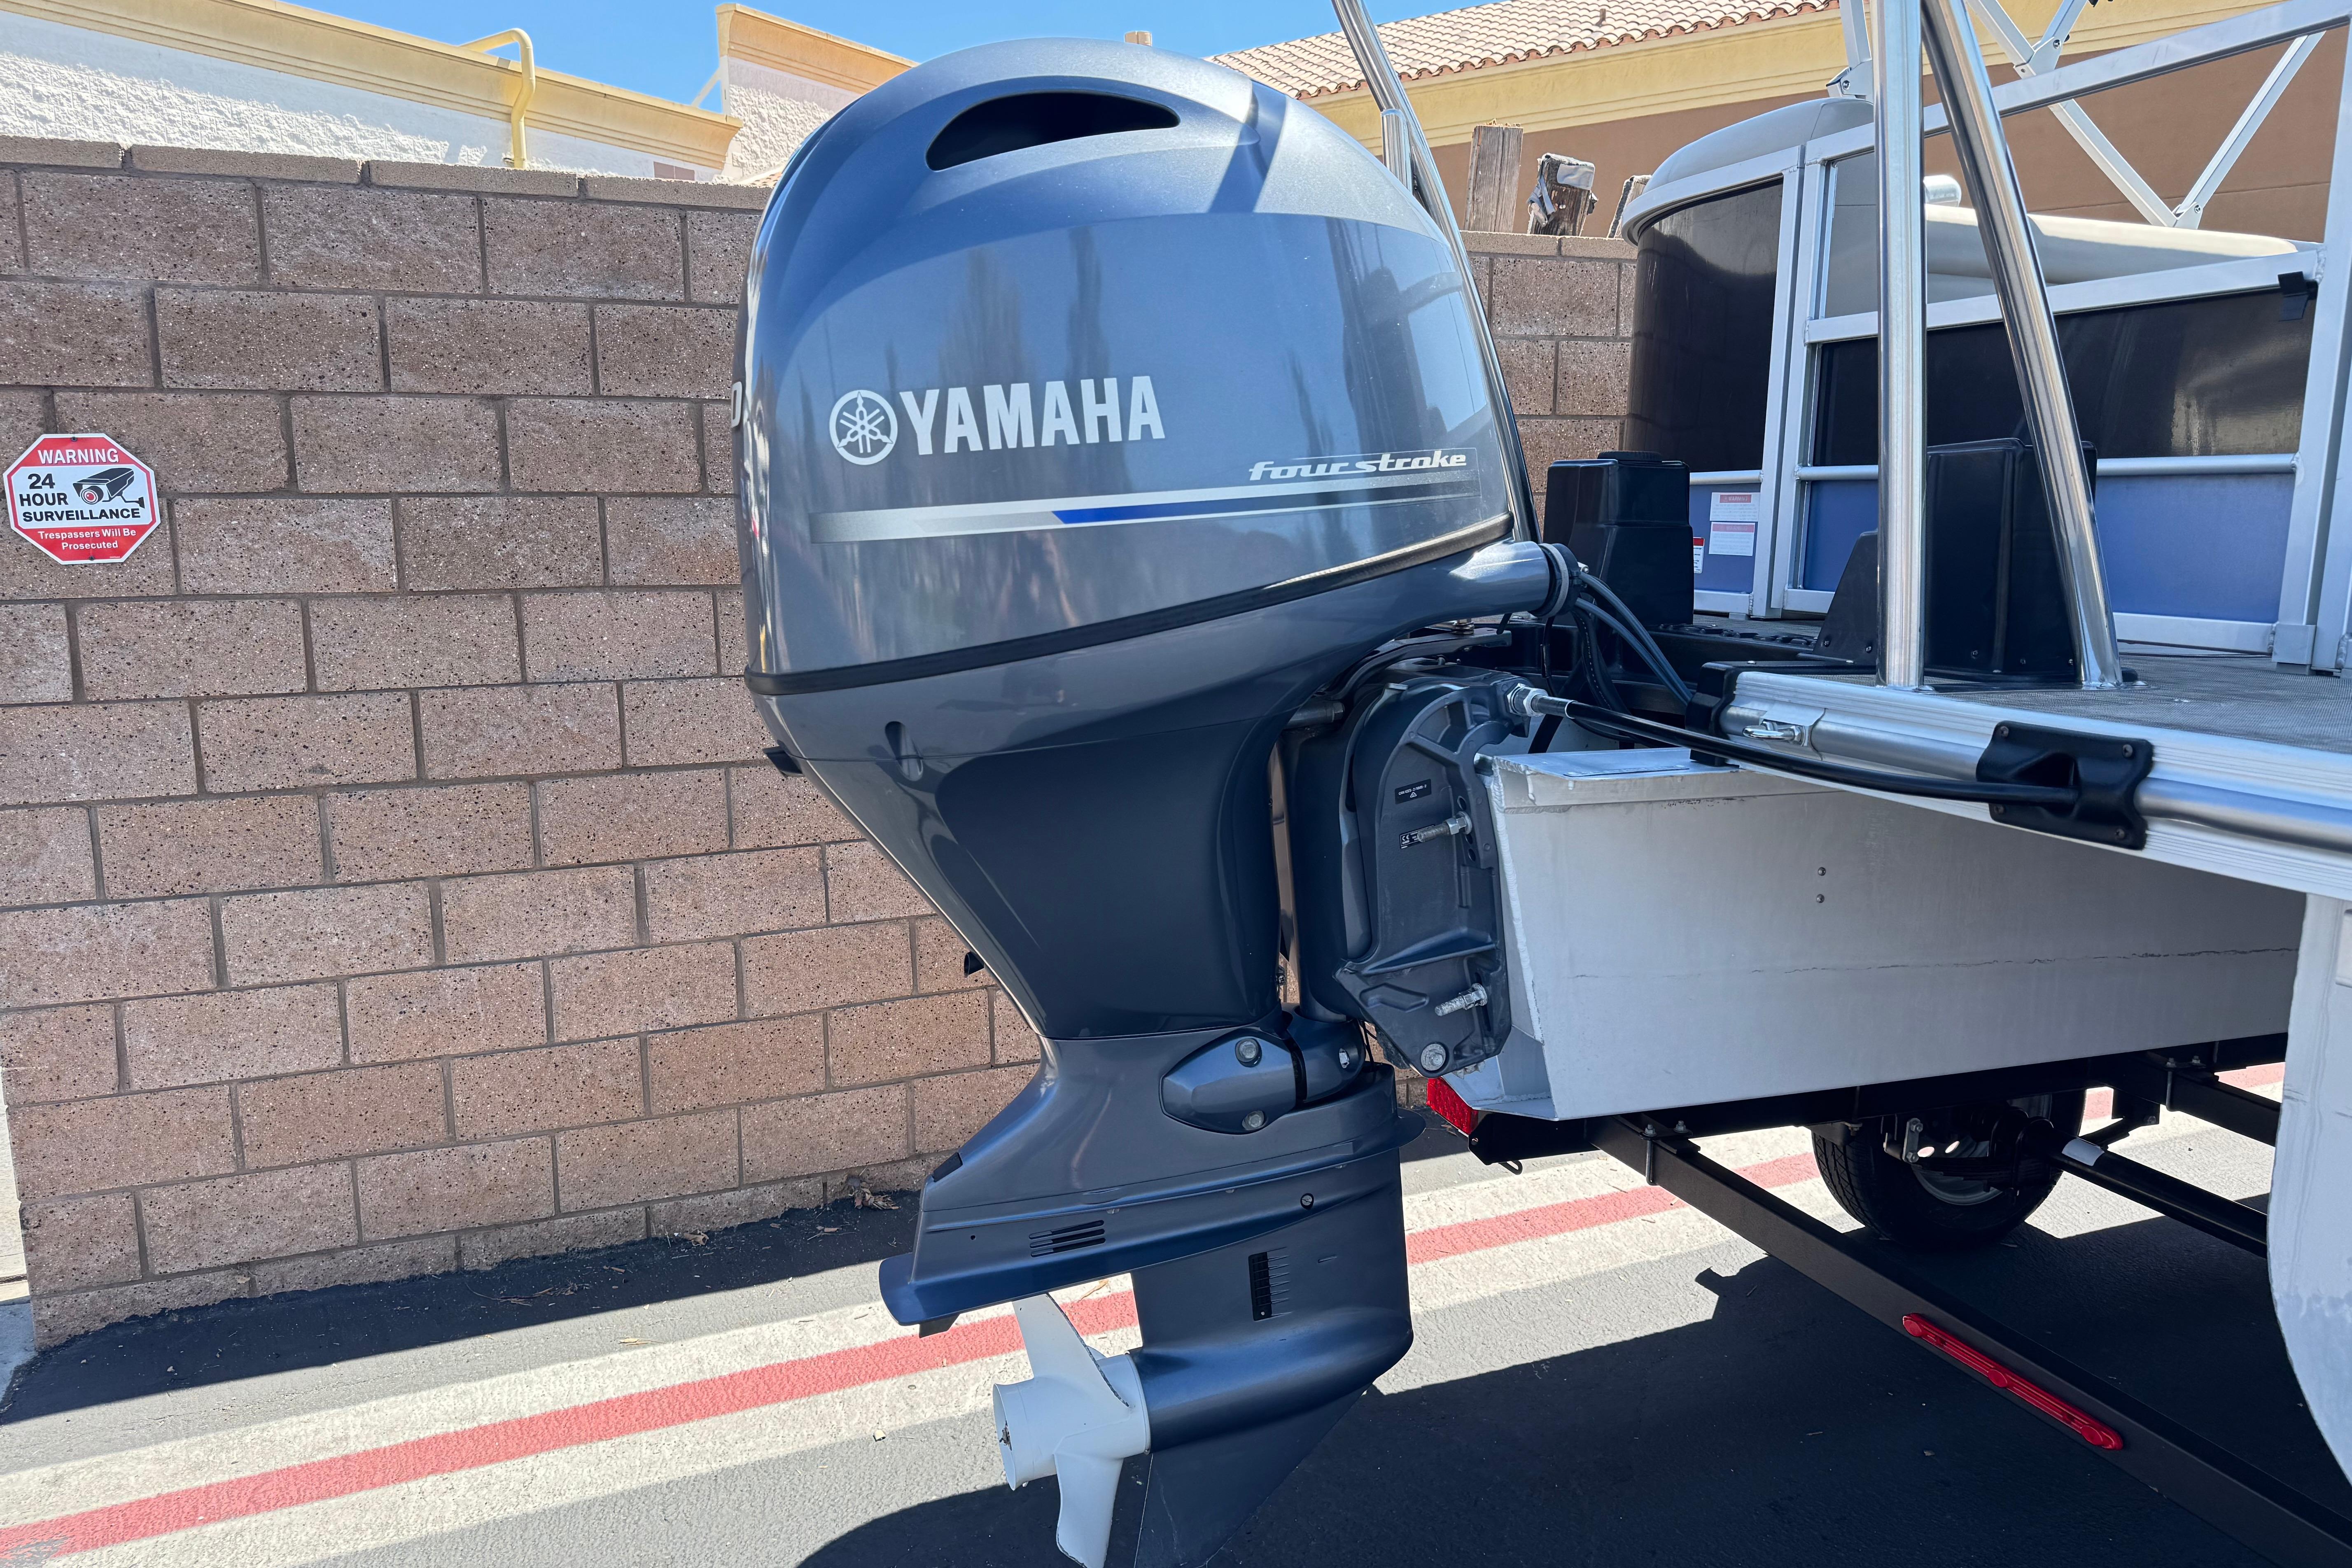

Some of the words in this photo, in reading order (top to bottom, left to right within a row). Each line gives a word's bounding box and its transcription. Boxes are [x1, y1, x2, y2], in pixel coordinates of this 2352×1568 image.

[899, 376, 1165, 455] YAMAHA
[37, 448, 119, 464] WARNING
[28, 474, 56, 489] 24
[19, 492, 69, 506] HOUR
[23, 508, 141, 522] SURVEILLANCE
[38, 530, 100, 540] Trespassers
[102, 528, 121, 537] Will
[123, 528, 136, 537] Be
[62, 540, 118, 550] Prosecuted
